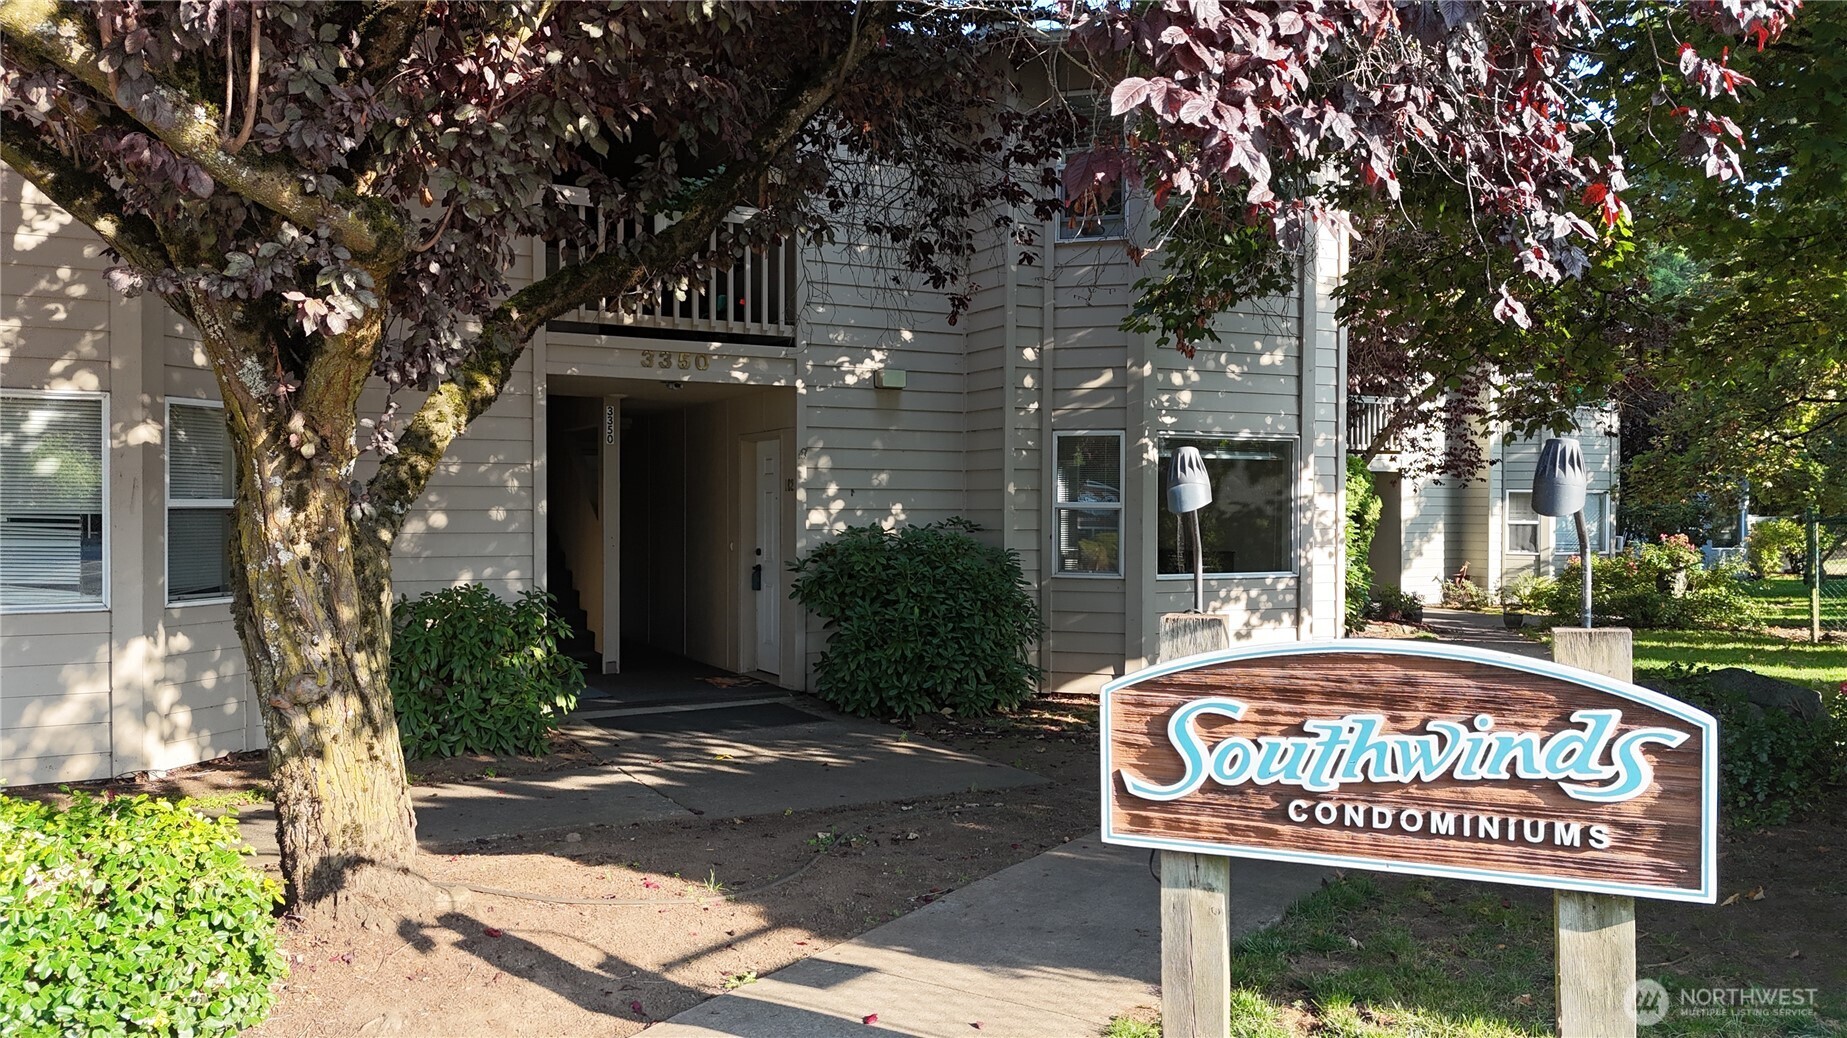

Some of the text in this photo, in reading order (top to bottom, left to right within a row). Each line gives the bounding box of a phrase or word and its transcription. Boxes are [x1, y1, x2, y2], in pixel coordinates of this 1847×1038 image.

[640, 349, 710, 371] 3350
[606, 406, 614, 444] 3350
[1121, 697, 1691, 803] Southwinds
[1287, 799, 1612, 849] CONDOMINIUMS
